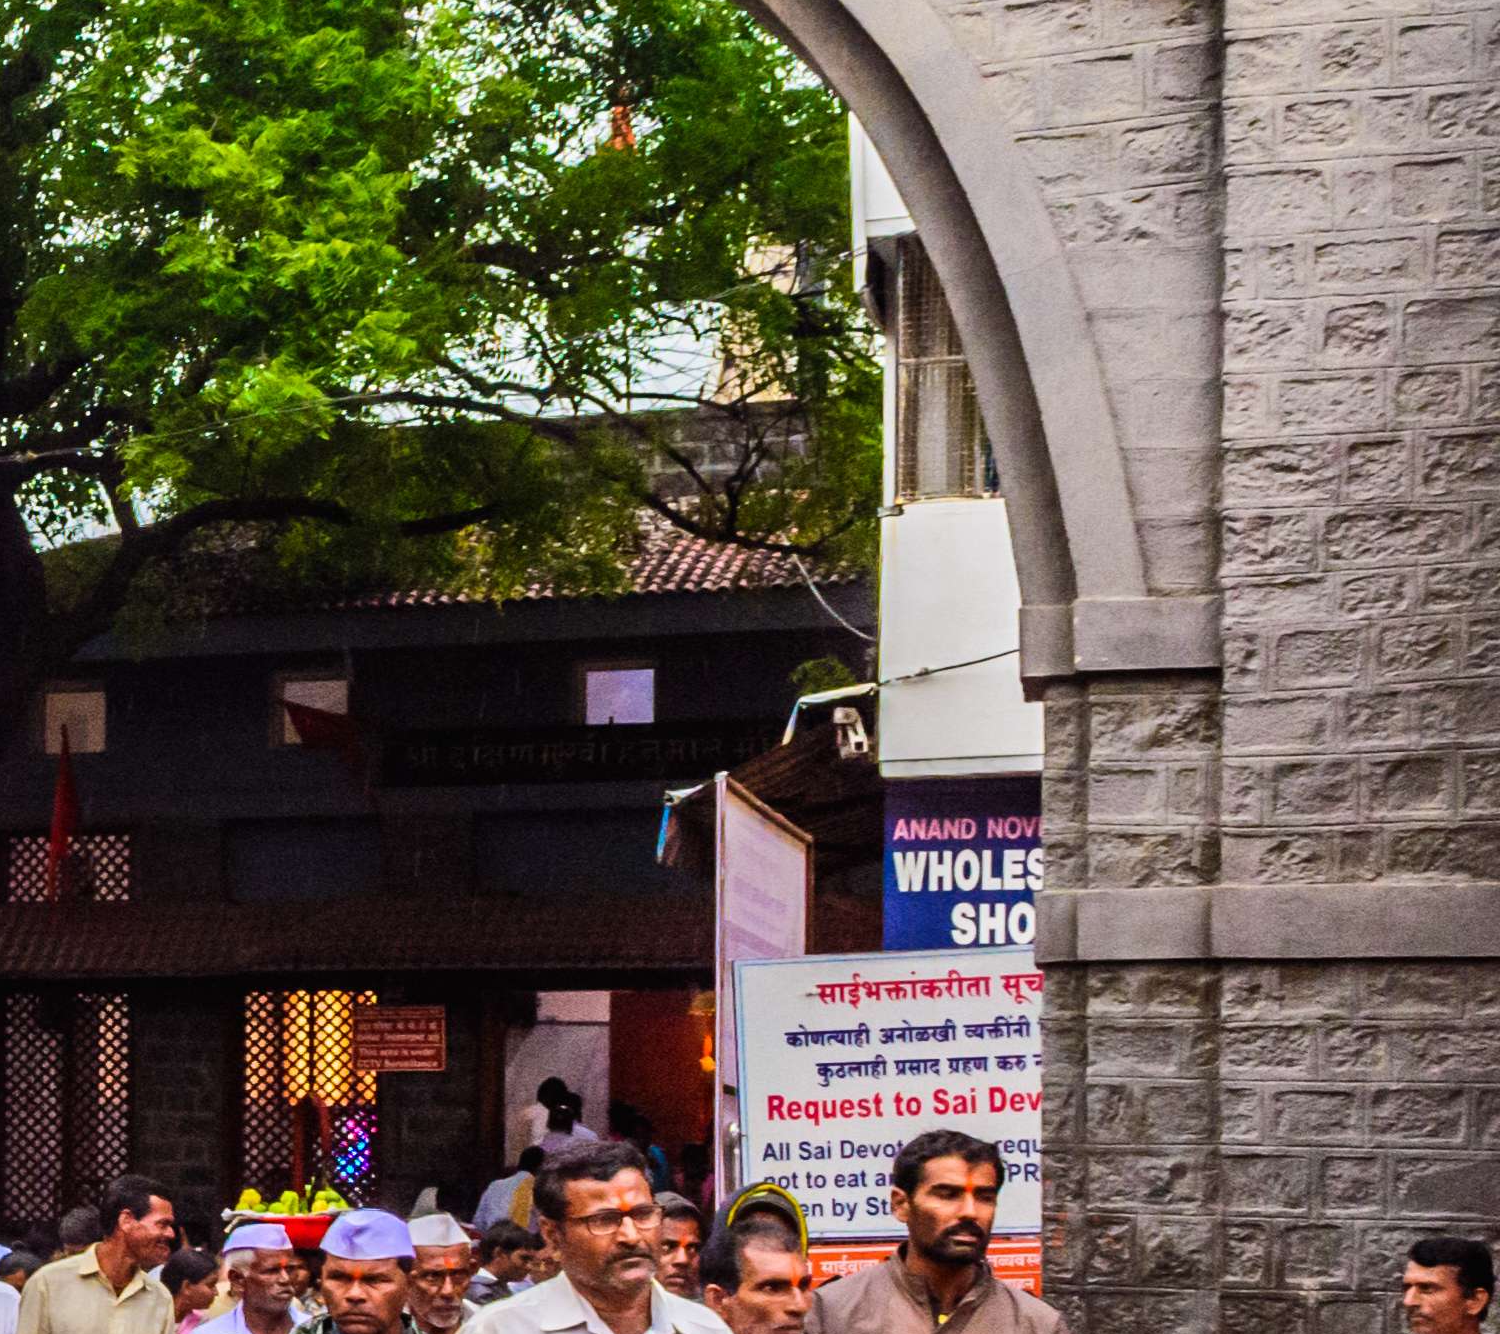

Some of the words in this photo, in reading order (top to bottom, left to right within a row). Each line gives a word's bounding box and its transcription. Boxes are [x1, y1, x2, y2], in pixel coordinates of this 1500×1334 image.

[892, 818, 977, 841] ANAND
[987, 816, 1043, 840] NOV
[951, 901, 1036, 945] SHO
[816, 969, 992, 1009] साईभक्तांकरीता
[784, 1022, 871, 1048] कोणत्याही
[879, 1018, 957, 1044] अनोळखी
[816, 1055, 887, 1087] कुठलाही
[894, 1058, 940, 1076] प्रसाद
[947, 1056, 988, 1075] ग्रहण
[767, 1092, 884, 1126] Request
[893, 1090, 921, 1117] to
[933, 1087, 978, 1115] Sai
[989, 1086, 1043, 1113] Dev
[762, 1142, 790, 1161] All
[799, 1141, 832, 1160] Sai
[806, 1172, 826, 1189] to
[834, 1170, 867, 1188] eat
[832, 1198, 858, 1221] by
[866, 1197, 891, 1215] St
